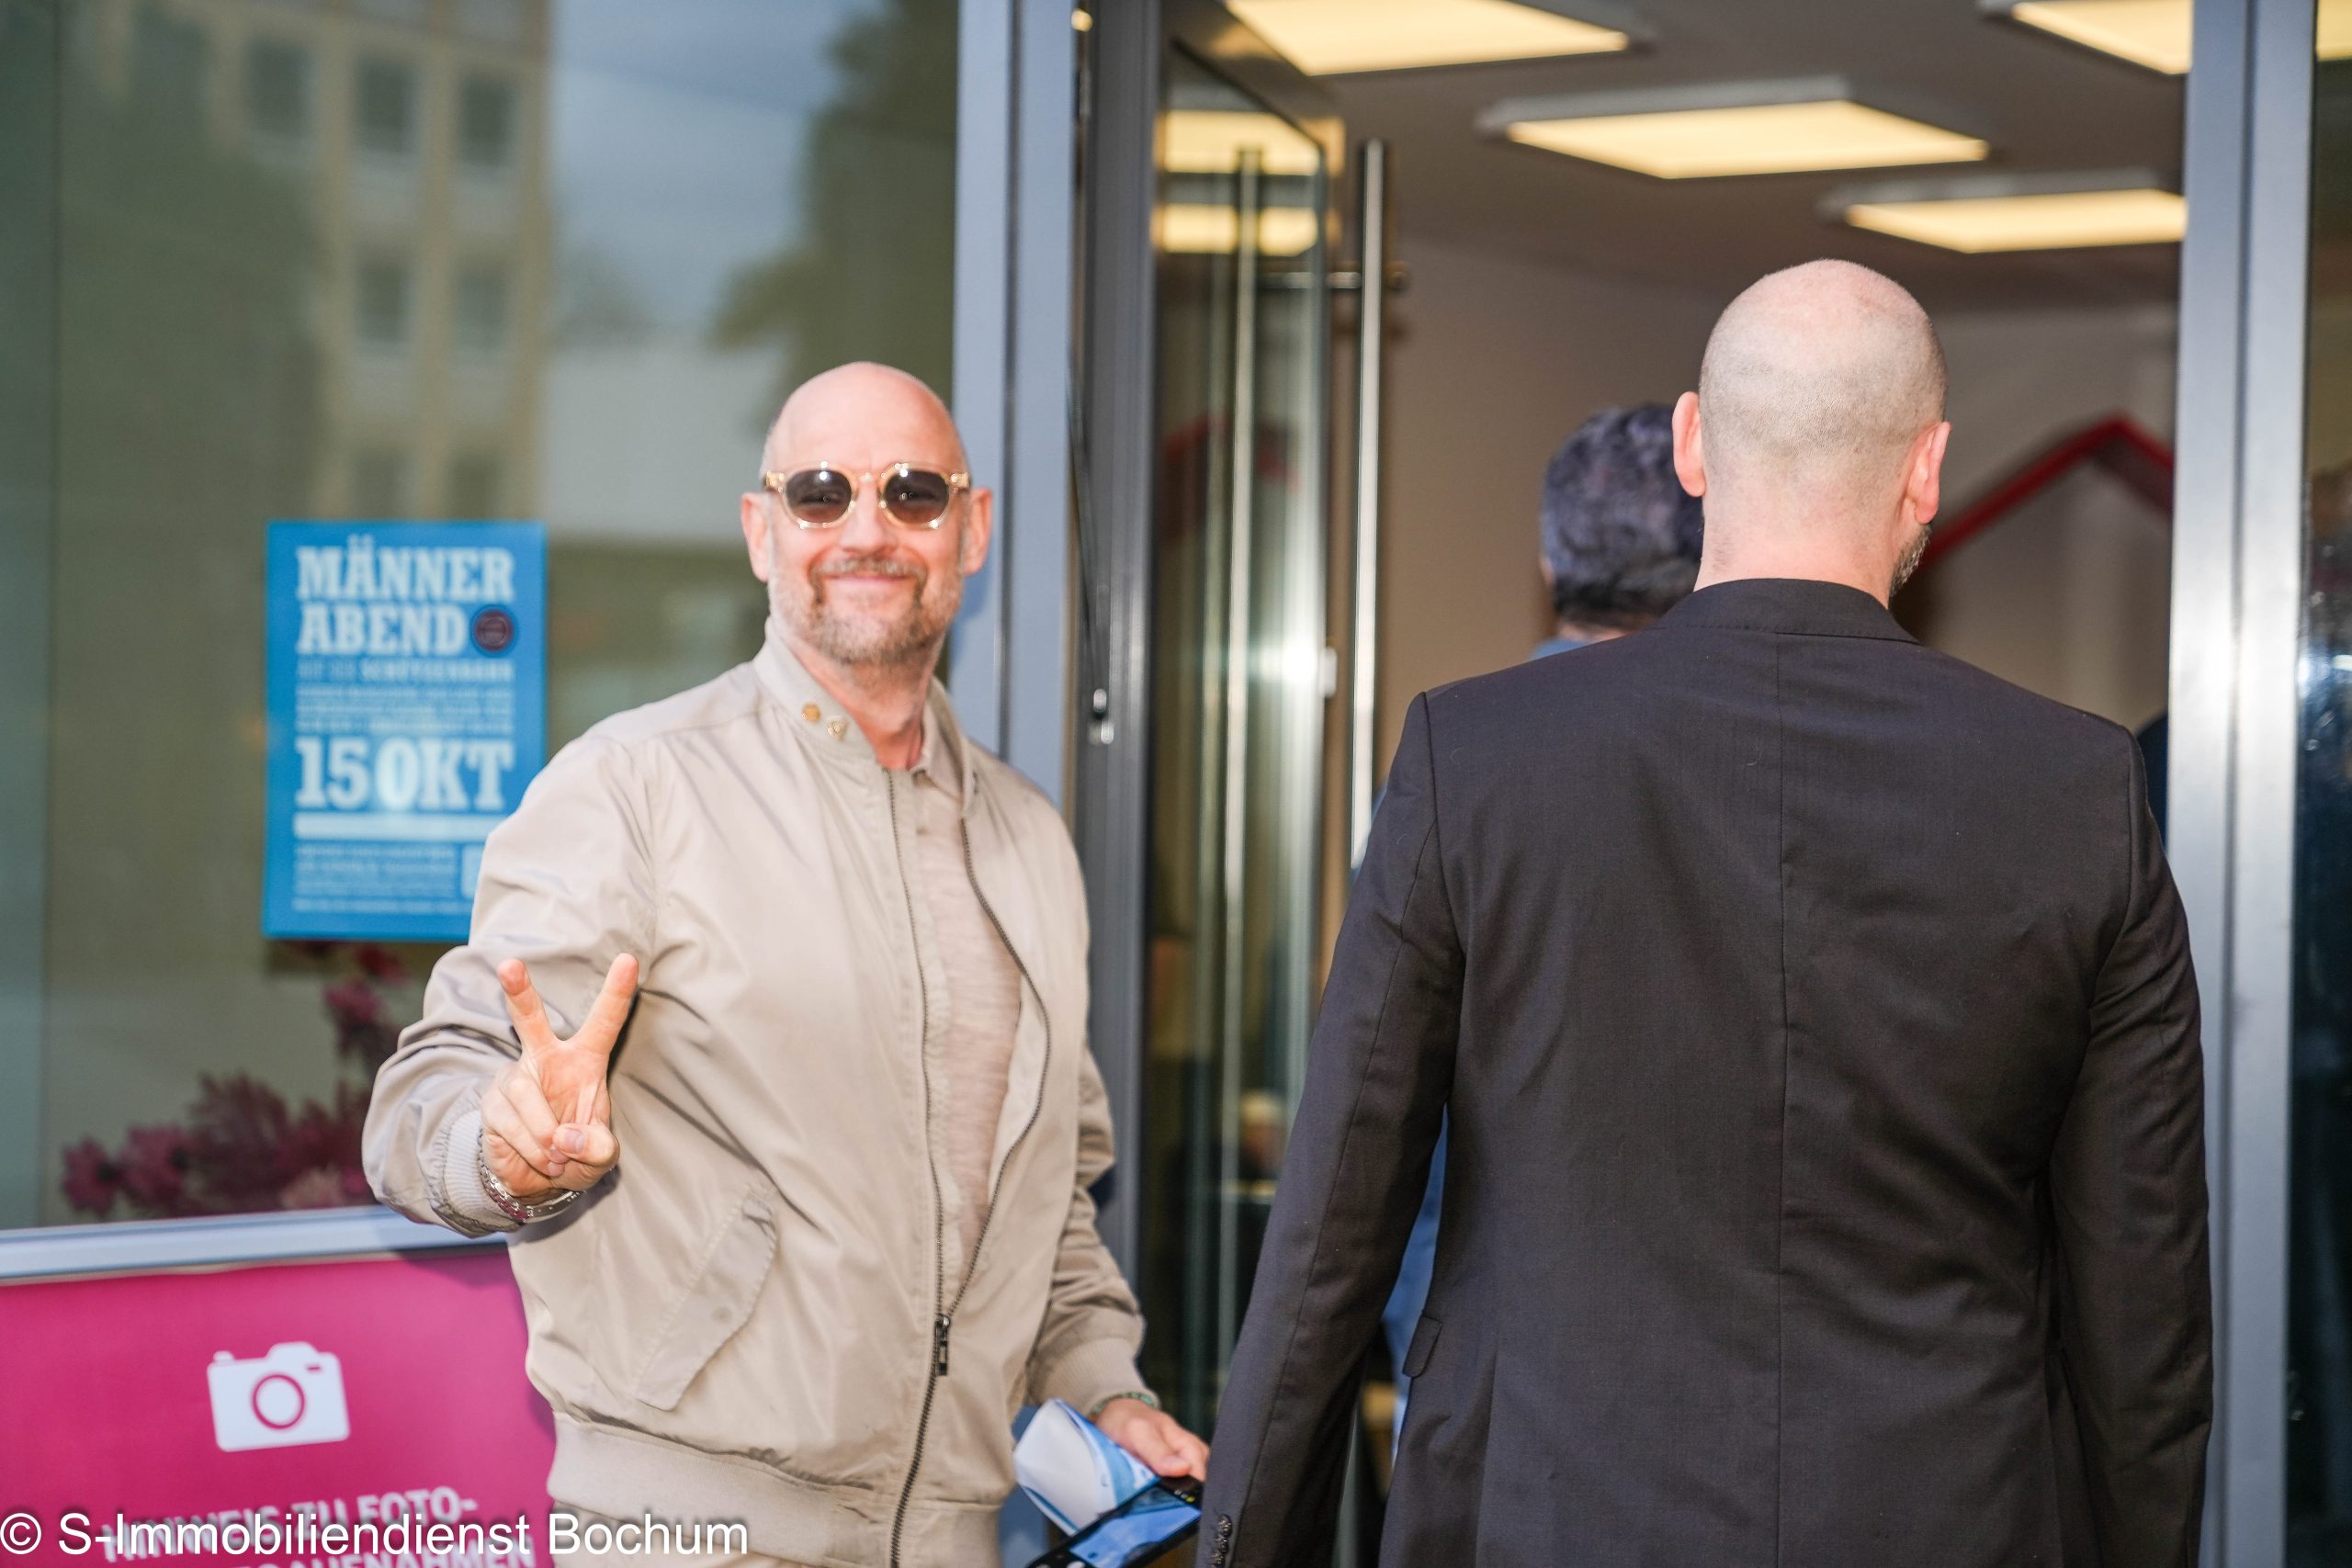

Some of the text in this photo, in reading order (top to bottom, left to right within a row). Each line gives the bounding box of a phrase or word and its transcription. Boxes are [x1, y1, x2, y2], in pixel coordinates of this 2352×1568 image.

[296, 535, 515, 601] MÄNNER
[296, 603, 468, 655] ABEND
[357, 1486, 478, 1533] FOTO-
